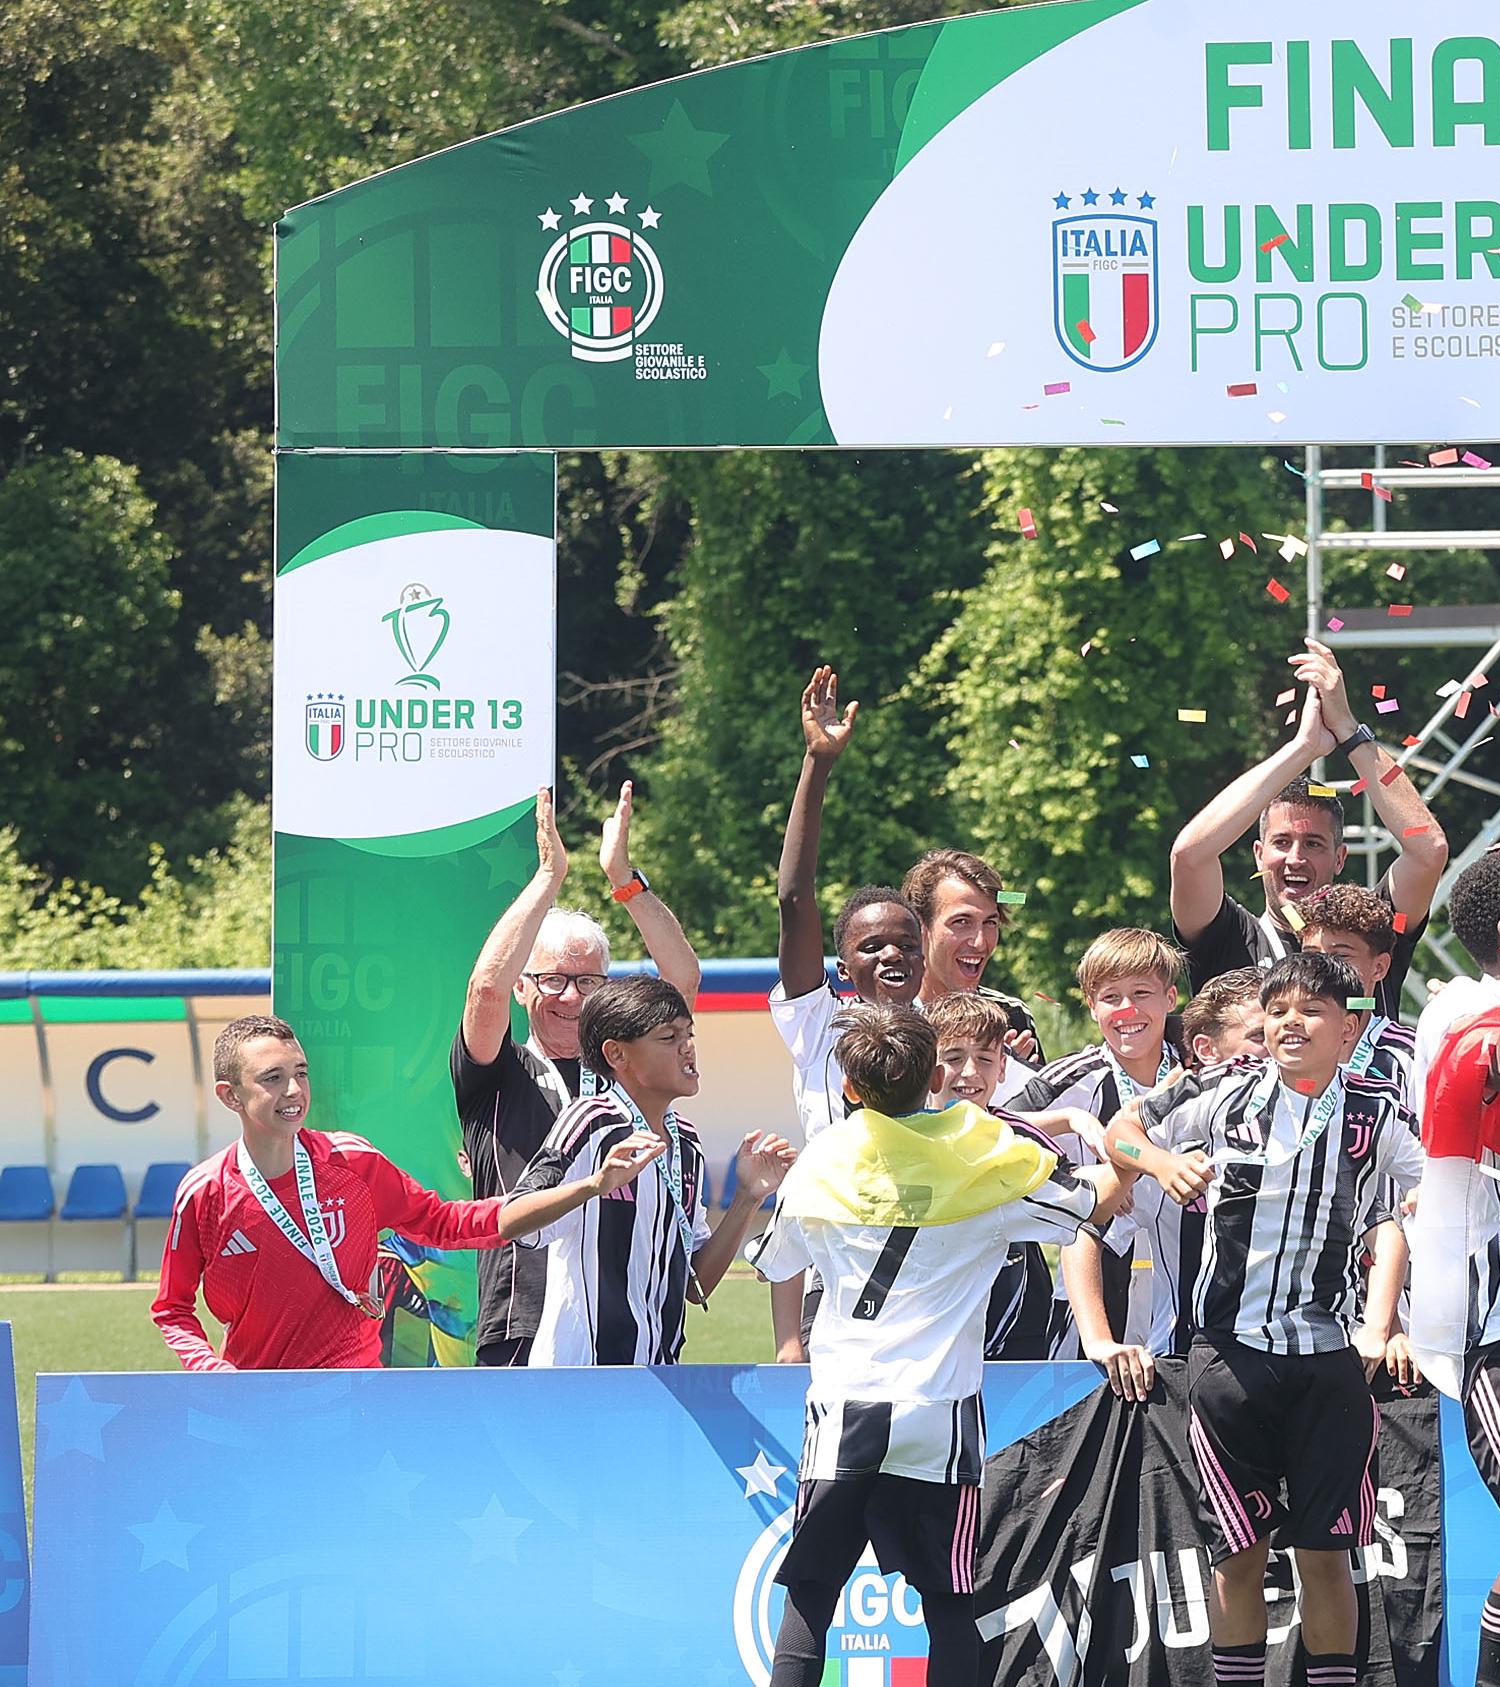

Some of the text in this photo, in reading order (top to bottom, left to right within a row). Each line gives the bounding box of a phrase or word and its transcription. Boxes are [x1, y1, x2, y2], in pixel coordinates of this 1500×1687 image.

[1062, 229, 1149, 257] ITALIA
[1093, 259, 1119, 271] FIGC
[570, 266, 632, 294] FIGC
[589, 295, 613, 304] ITALIA
[1392, 304, 1500, 329] SETTORE
[1190, 292, 1368, 372] PRO
[635, 343, 684, 356] SETTORE
[1392, 336, 1405, 359] E
[635, 355, 705, 368] GIOVANILE E
[635, 367, 707, 380] SCOLASTICO
[309, 707, 342, 719] ITALIA
[355, 699, 523, 729] UNDER 13
[356, 732, 422, 762] PRO
[430, 737, 523, 748] SETTORE GIOVANILE
[430, 748, 495, 758] E SCOLASTICO
[85, 1047, 161, 1123] C
[1317, 1088, 1338, 1116] 2026
[246, 1166, 308, 1249] FINALE 2026
[296, 1151, 326, 1246] FINALE 2026
[832, 1573, 925, 1628] IGC
[840, 1633, 891, 1651] ITALIA
